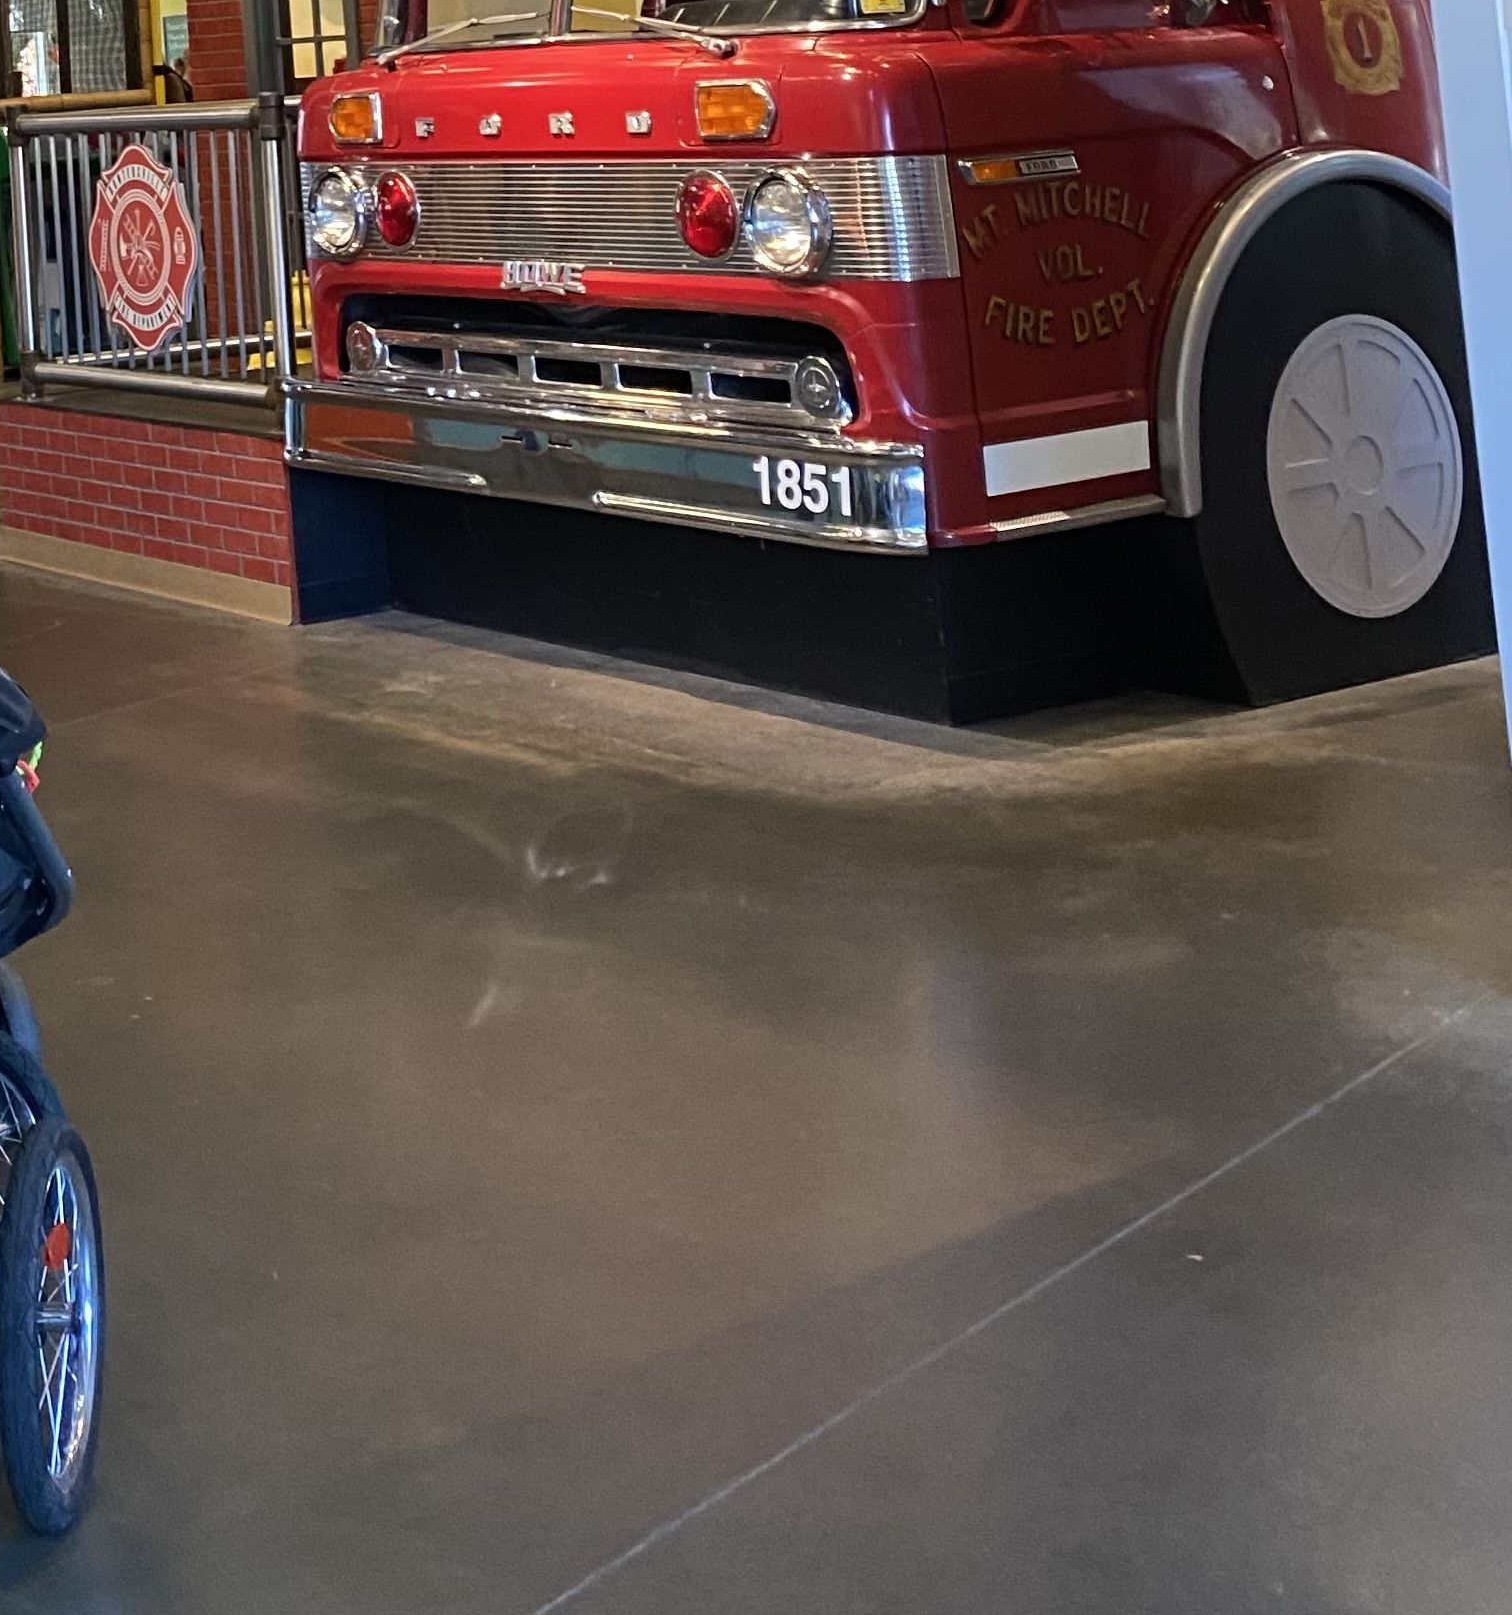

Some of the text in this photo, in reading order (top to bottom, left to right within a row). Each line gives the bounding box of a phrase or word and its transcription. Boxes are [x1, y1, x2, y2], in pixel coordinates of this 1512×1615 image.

[414, 111, 653, 138] FORD
[1014, 181, 1151, 239] MITCHELL
[502, 260, 587, 292] HOWE
[1038, 242, 1104, 284] VOL.
[984, 278, 1156, 345] FIRE DEPT.
[752, 455, 852, 517] 1851
